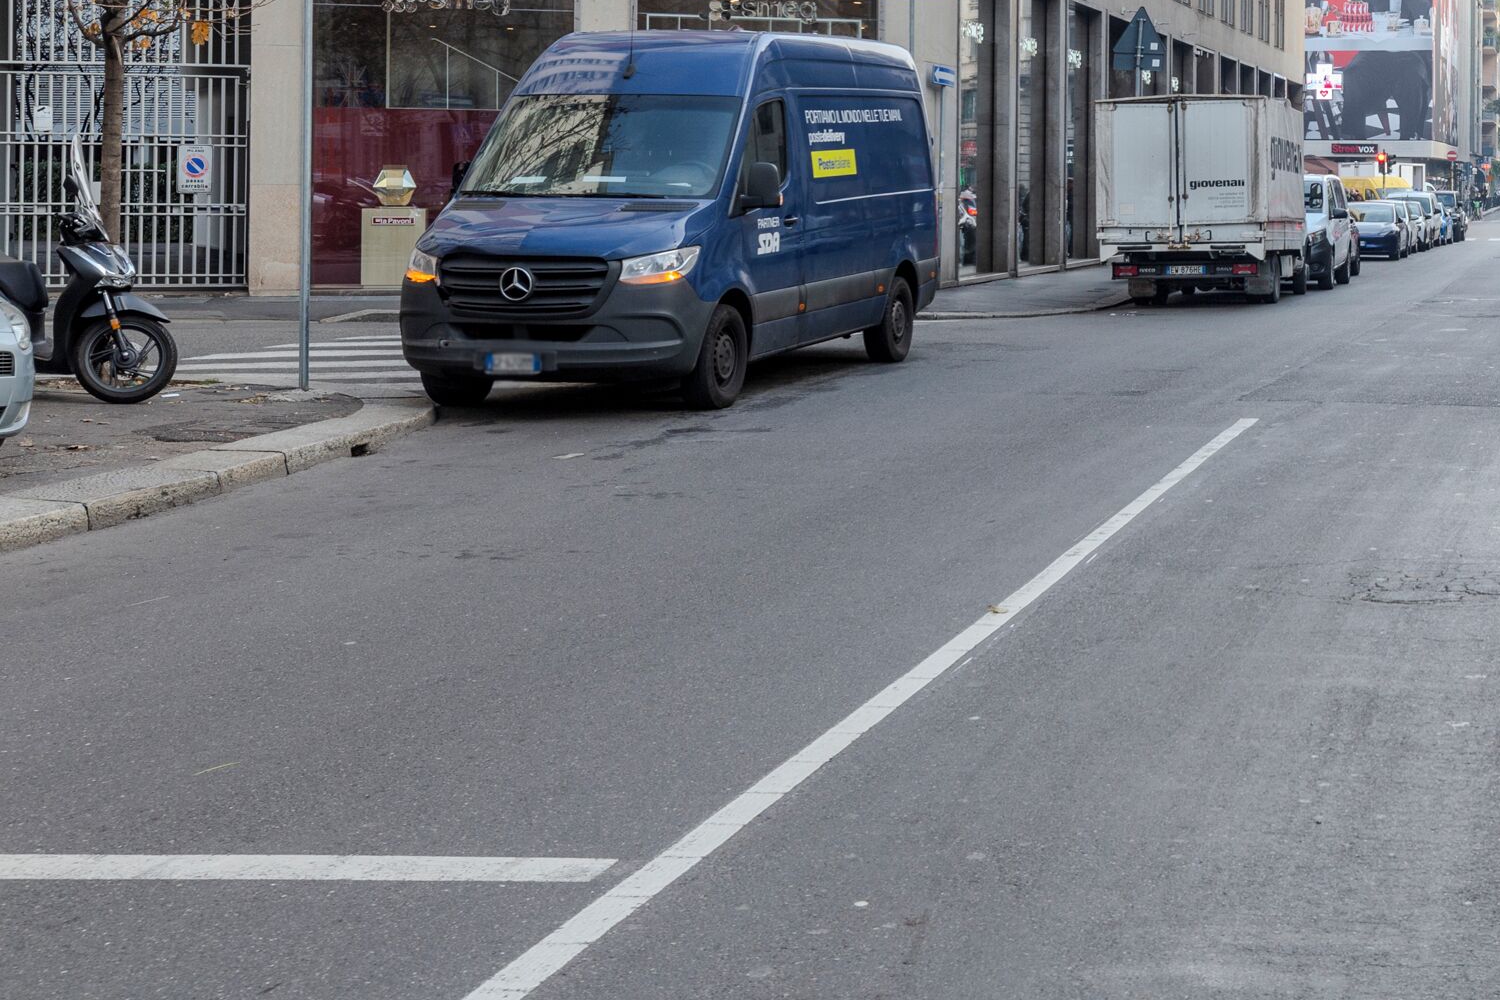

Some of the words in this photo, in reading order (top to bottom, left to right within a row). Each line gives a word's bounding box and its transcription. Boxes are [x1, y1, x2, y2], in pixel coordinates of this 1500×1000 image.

[741, 0, 817, 24] smeg
[804, 109, 836, 125] PORTIAMO
[841, 109, 861, 123] MONDO
[861, 108, 879, 123] NELLE
[878, 108, 889, 122] TUE
[1332, 144, 1375, 153] Streetvox
[1189, 178, 1245, 191] giovenali
[757, 216, 780, 229] PARTNER
[757, 231, 780, 255] SDA
